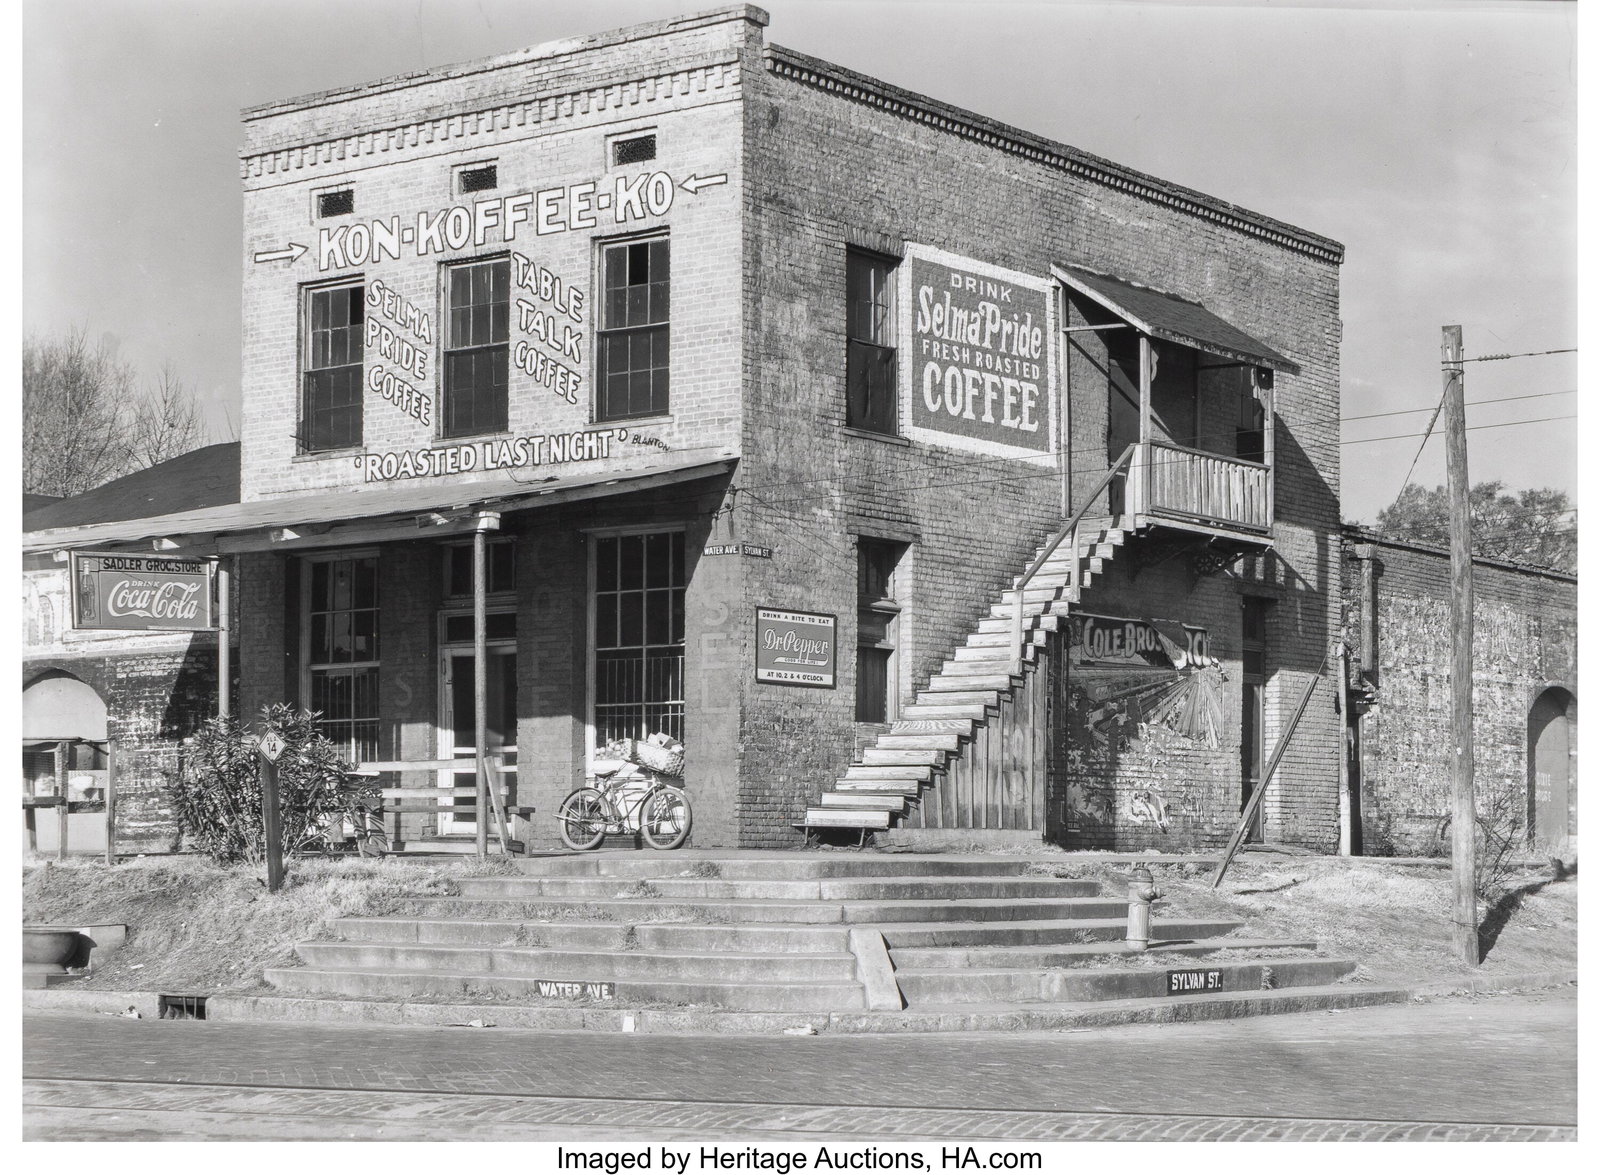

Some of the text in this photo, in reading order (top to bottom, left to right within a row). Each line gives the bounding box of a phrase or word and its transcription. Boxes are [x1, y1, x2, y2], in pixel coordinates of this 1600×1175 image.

[318, 170, 675, 272] KON-KOFFEE-KO
[512, 252, 584, 323] TABLE
[951, 273, 1012, 302] DRINK
[367, 279, 431, 344] SELMA
[516, 298, 583, 364] TALK
[366, 316, 428, 381] PRIDE
[922, 339, 1040, 380] FRESH ROASTED
[514, 340, 582, 405] COFFEE
[368, 365, 432, 427] COFFEE
[923, 361, 1040, 433] COFFEE
[484, 436, 545, 470] LAST
[103, 558, 142, 571] SADLER
[704, 546, 724, 556] WATER
[744, 546, 762, 557] SYLVAN
[108, 580, 202, 620] Coca-Cola
[783, 629, 829, 661] Pepper
[1083, 617, 1122, 659] COLE
[802, 674, 824, 682] O'CLOCK
[267, 742, 277, 755] 14
[538, 982, 582, 998] WATER
[1171, 972, 1222, 991] SYLVAN ST.
